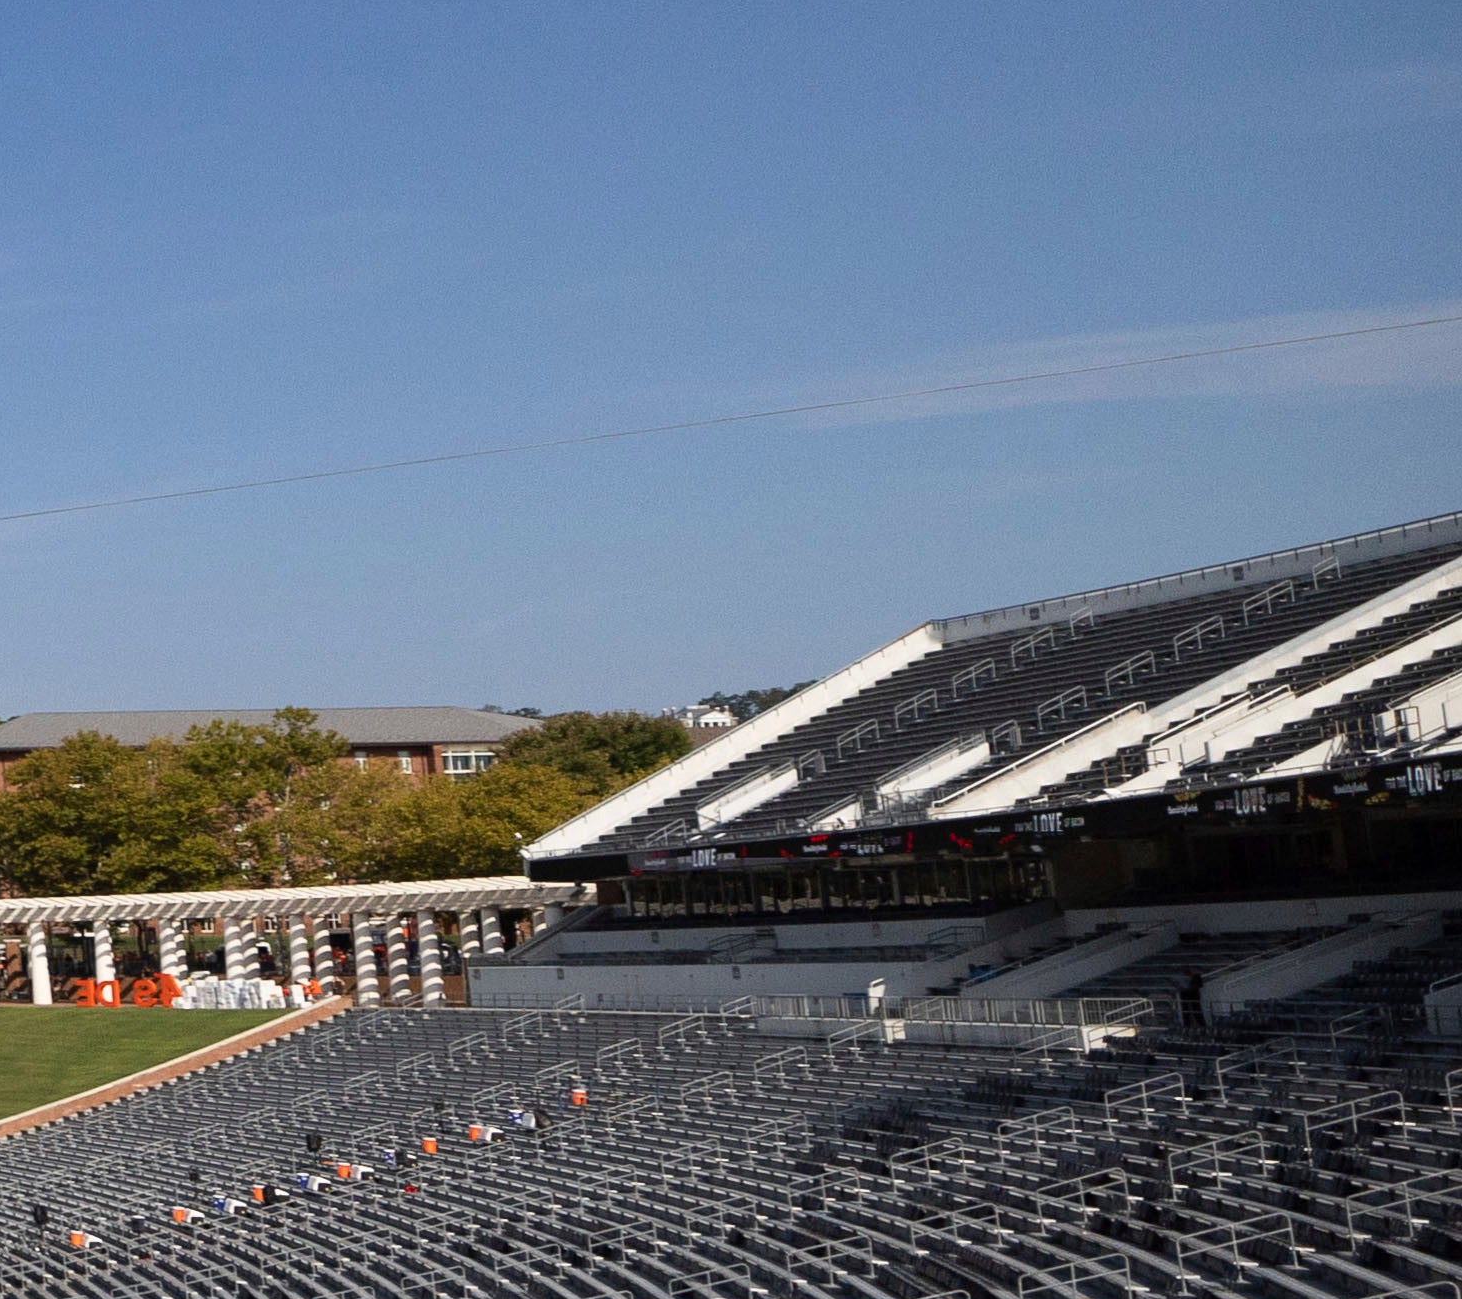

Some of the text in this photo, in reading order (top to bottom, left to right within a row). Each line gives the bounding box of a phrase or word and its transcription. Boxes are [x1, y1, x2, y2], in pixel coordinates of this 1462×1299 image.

[1406, 762, 1443, 796] LOVE
[1234, 787, 1267, 816] LOVE
[1032, 812, 1063, 833] LOVE
[692, 848, 717, 868] LOVE
